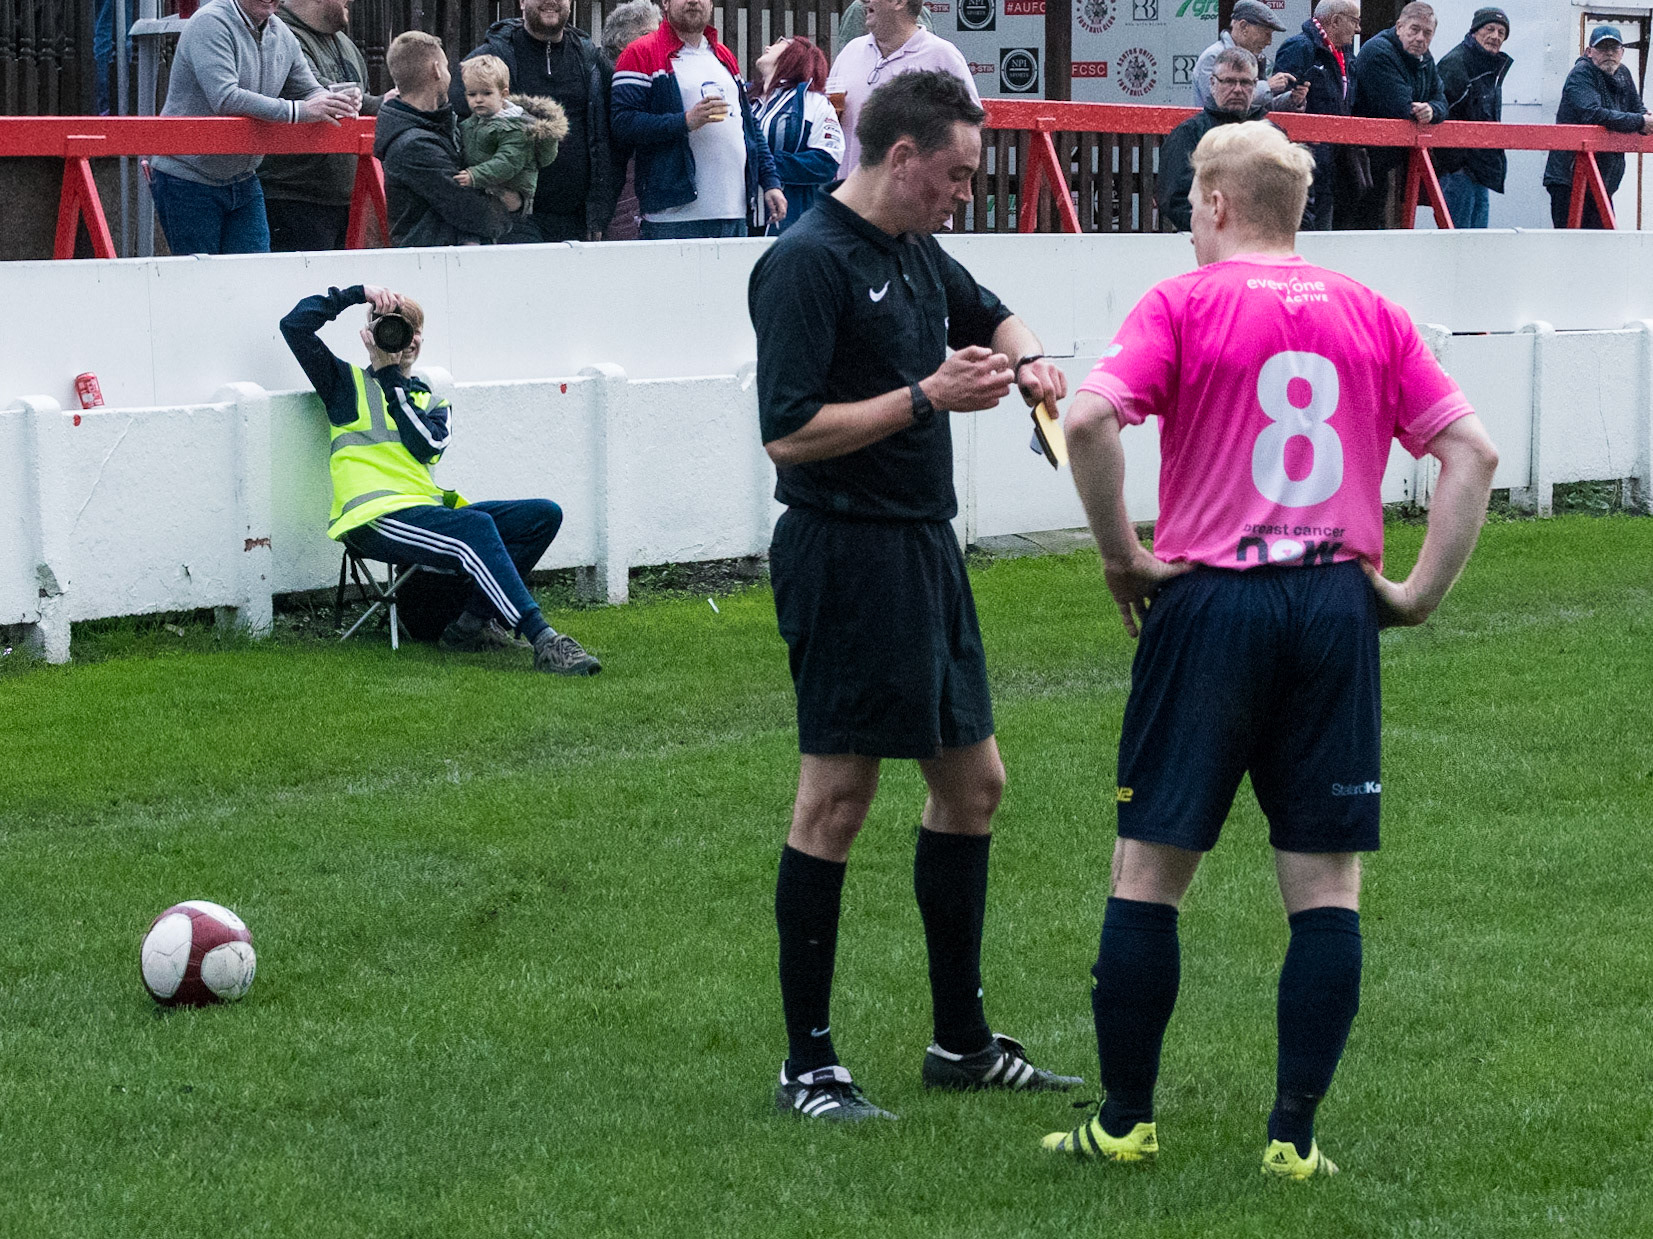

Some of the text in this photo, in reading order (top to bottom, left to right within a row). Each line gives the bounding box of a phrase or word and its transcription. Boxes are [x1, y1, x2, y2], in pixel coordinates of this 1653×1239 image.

[1071, 64, 1106, 76] FCSC
[1246, 276, 1326, 294] everyone
[1285, 293, 1329, 303] ACTIVE
[1251, 350, 1344, 508] 8
[1243, 523, 1346, 538] breast cancer
[1236, 535, 1344, 566] now
